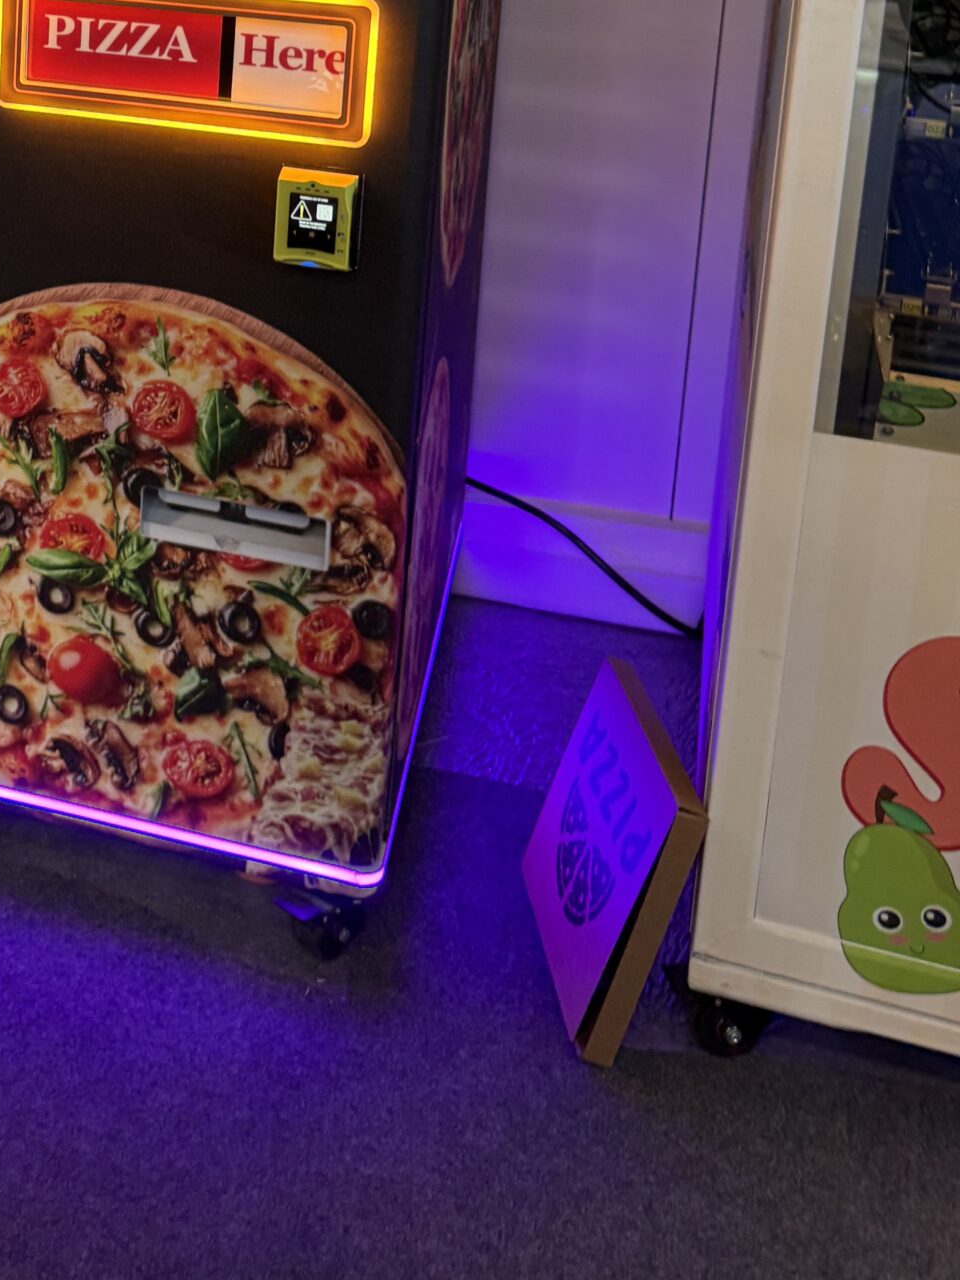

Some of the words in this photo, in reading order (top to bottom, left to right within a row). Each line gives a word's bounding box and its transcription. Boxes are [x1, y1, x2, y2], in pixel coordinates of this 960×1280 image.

[43, 12, 198, 64] PIZZA
[239, 33, 346, 76] Here
[579, 709, 653, 875] PIZZA
